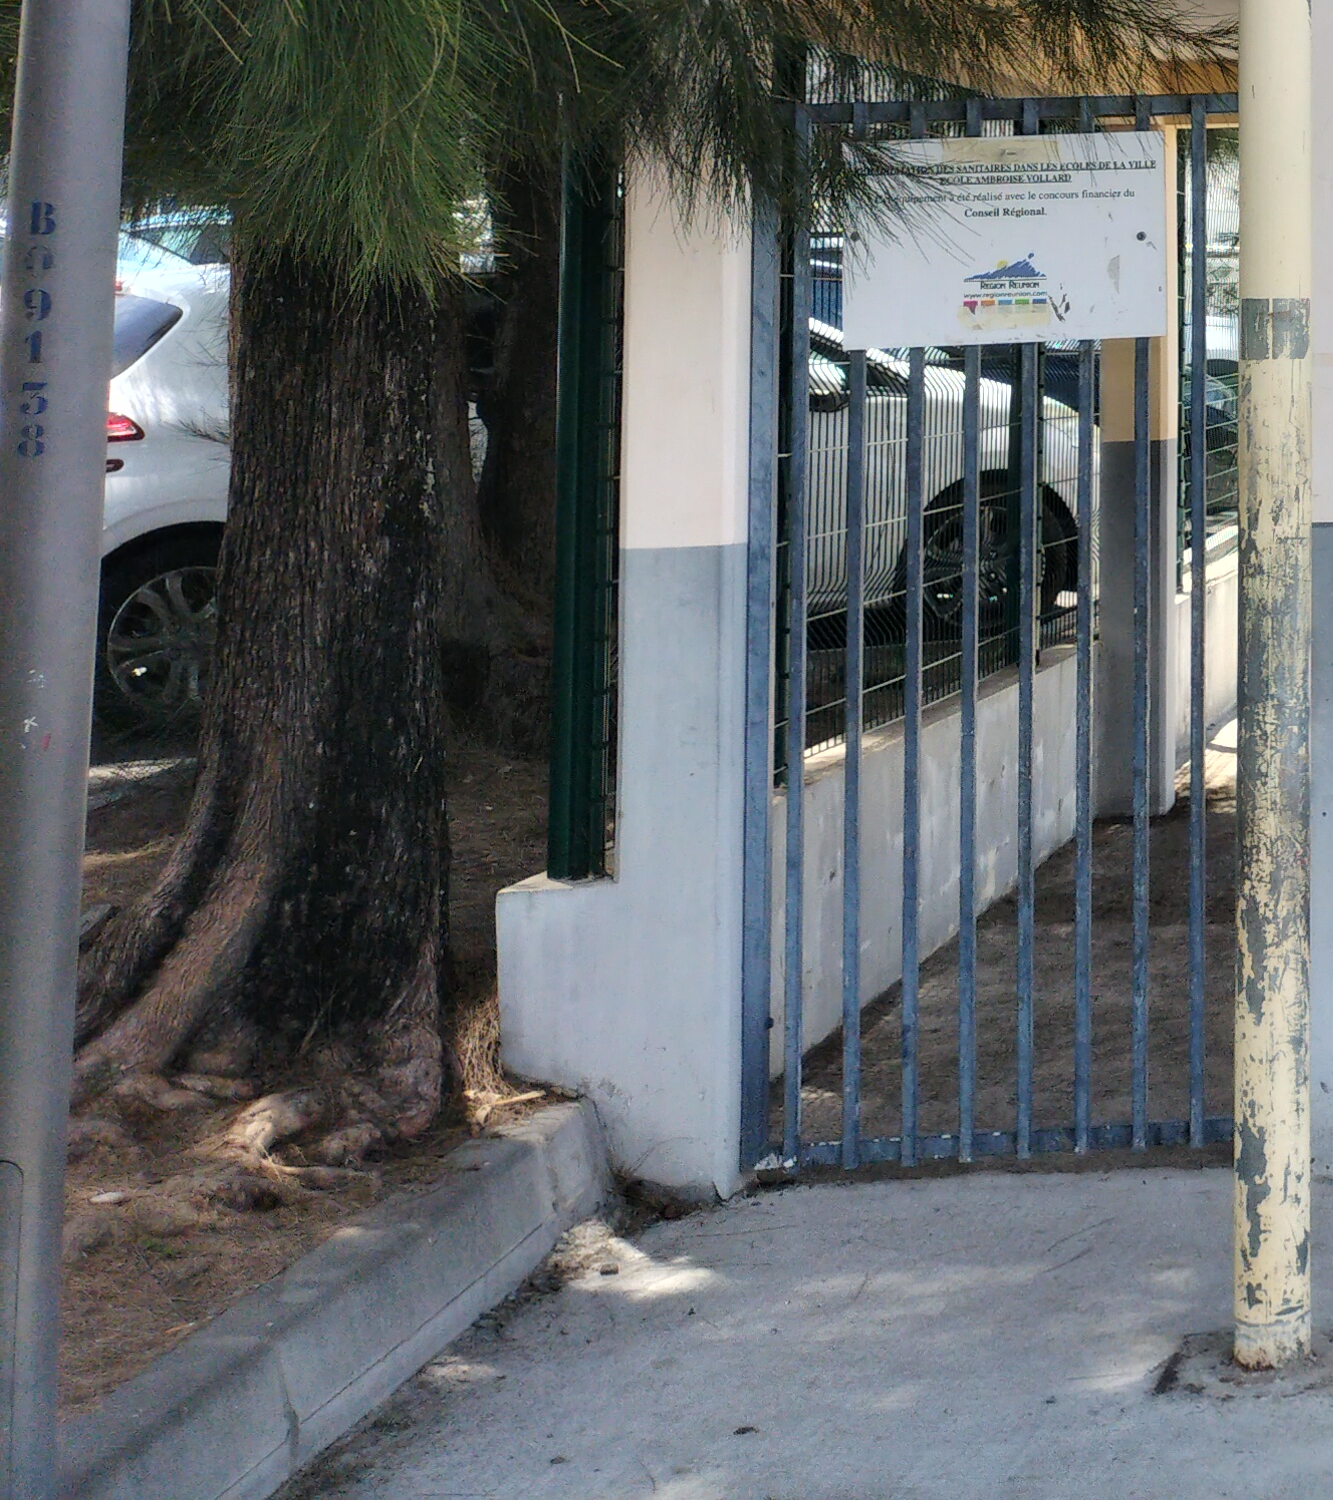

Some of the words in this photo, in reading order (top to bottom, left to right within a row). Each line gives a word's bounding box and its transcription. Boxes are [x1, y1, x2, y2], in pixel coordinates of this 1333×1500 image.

[957, 162, 1012, 174] SANITAIRES
[1014, 162, 1038, 172] DANS
[1040, 162, 1058, 172] LES
[1099, 161, 1111, 170] DE
[1128, 160, 1157, 170] VILLE
[975, 174, 1024, 185] AMBROISE
[1026, 173, 1072, 183] VOLLARD
[1005, 192, 1025, 200] avec
[1028, 191, 1036, 199] le
[1038, 191, 1079, 199] concours
[1081, 189, 1121, 198] financier
[1123, 188, 1135, 198] du
[964, 207, 1000, 217] Conseil
[1003, 206, 1047, 219] Régional.
[964, 290, 1047, 299] www.regionreunion.com
